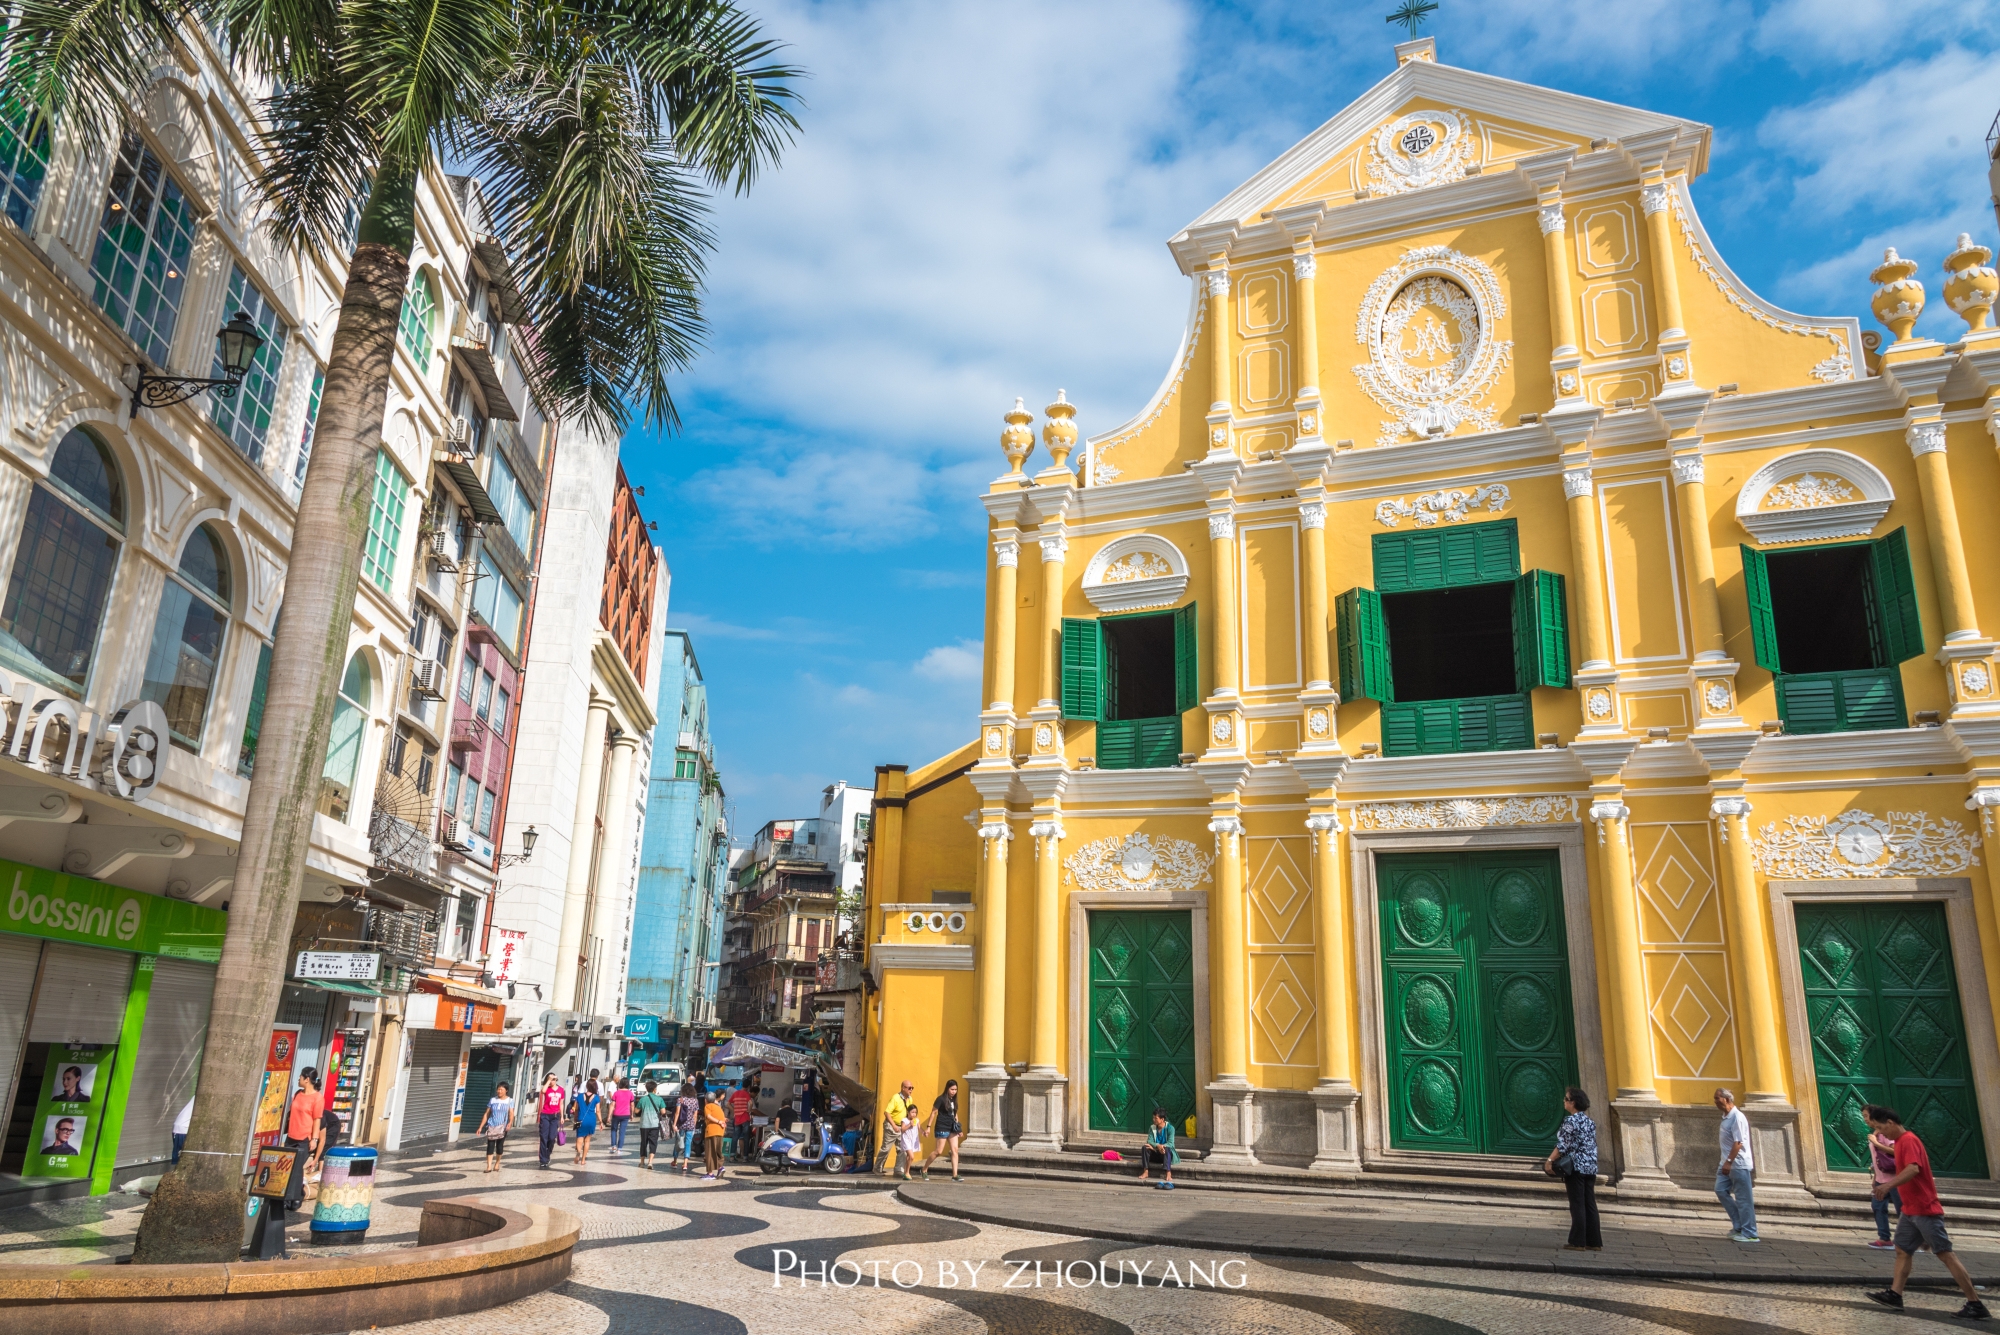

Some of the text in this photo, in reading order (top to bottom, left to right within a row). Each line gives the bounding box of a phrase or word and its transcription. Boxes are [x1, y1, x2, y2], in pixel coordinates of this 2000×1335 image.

[8, 870, 113, 938] bossini
[496, 942, 516, 987] 營業中
[473, 1008, 494, 1025] FORTRESS
[71, 1051, 79, 1061] 2
[61, 1103, 67, 1112] 1
[48, 1156, 56, 1166] G
[276, 1154, 292, 1172] 600
